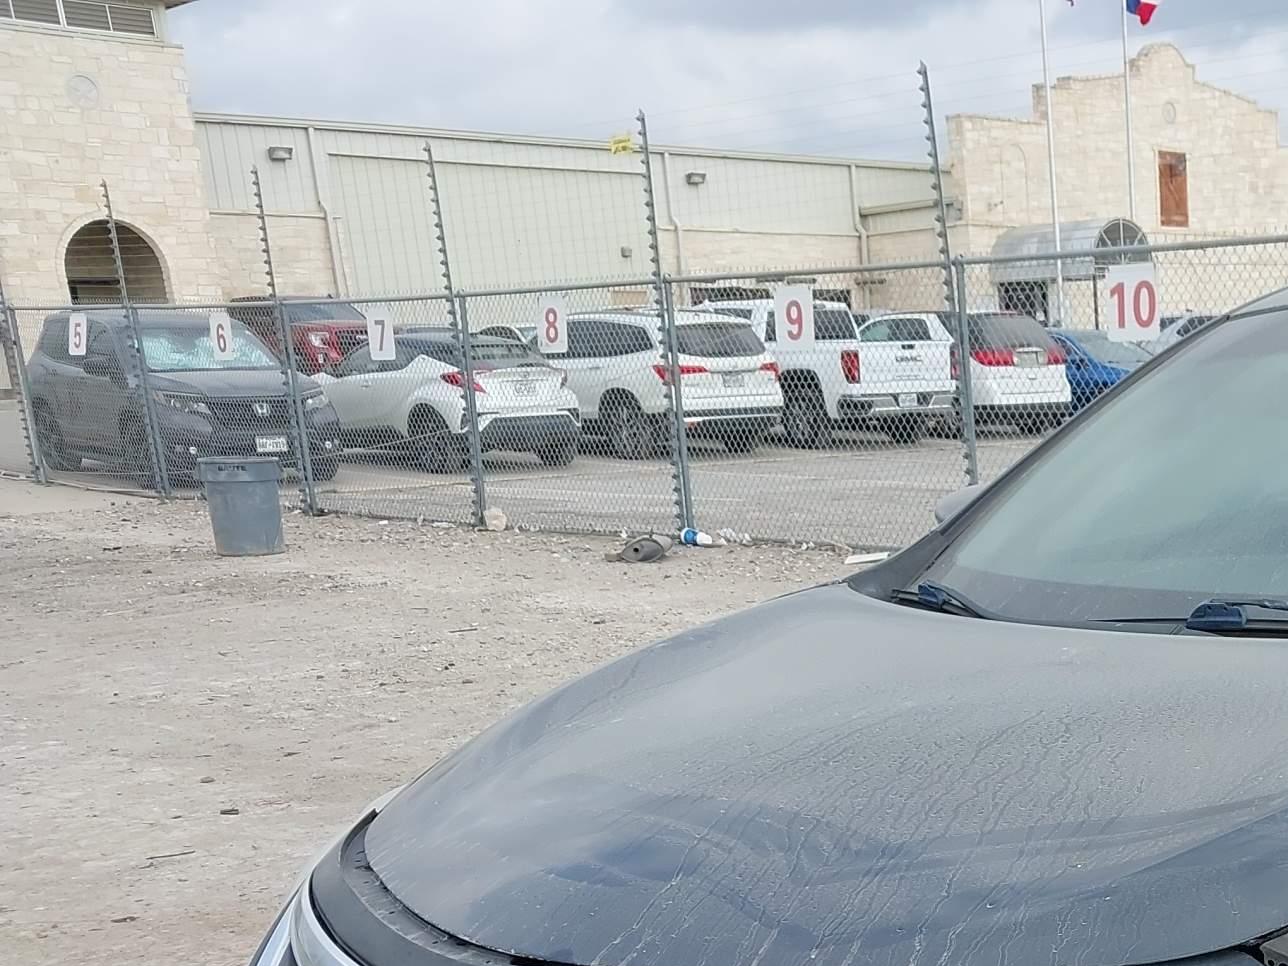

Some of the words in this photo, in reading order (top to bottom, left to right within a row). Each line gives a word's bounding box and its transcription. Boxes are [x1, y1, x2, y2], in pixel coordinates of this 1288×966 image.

[785, 299, 804, 341] 9
[1109, 280, 1157, 329] 10
[73, 322, 82, 349] 5
[216, 323, 227, 353] 6
[374, 320, 385, 352] 7
[544, 307, 559, 344] 8
